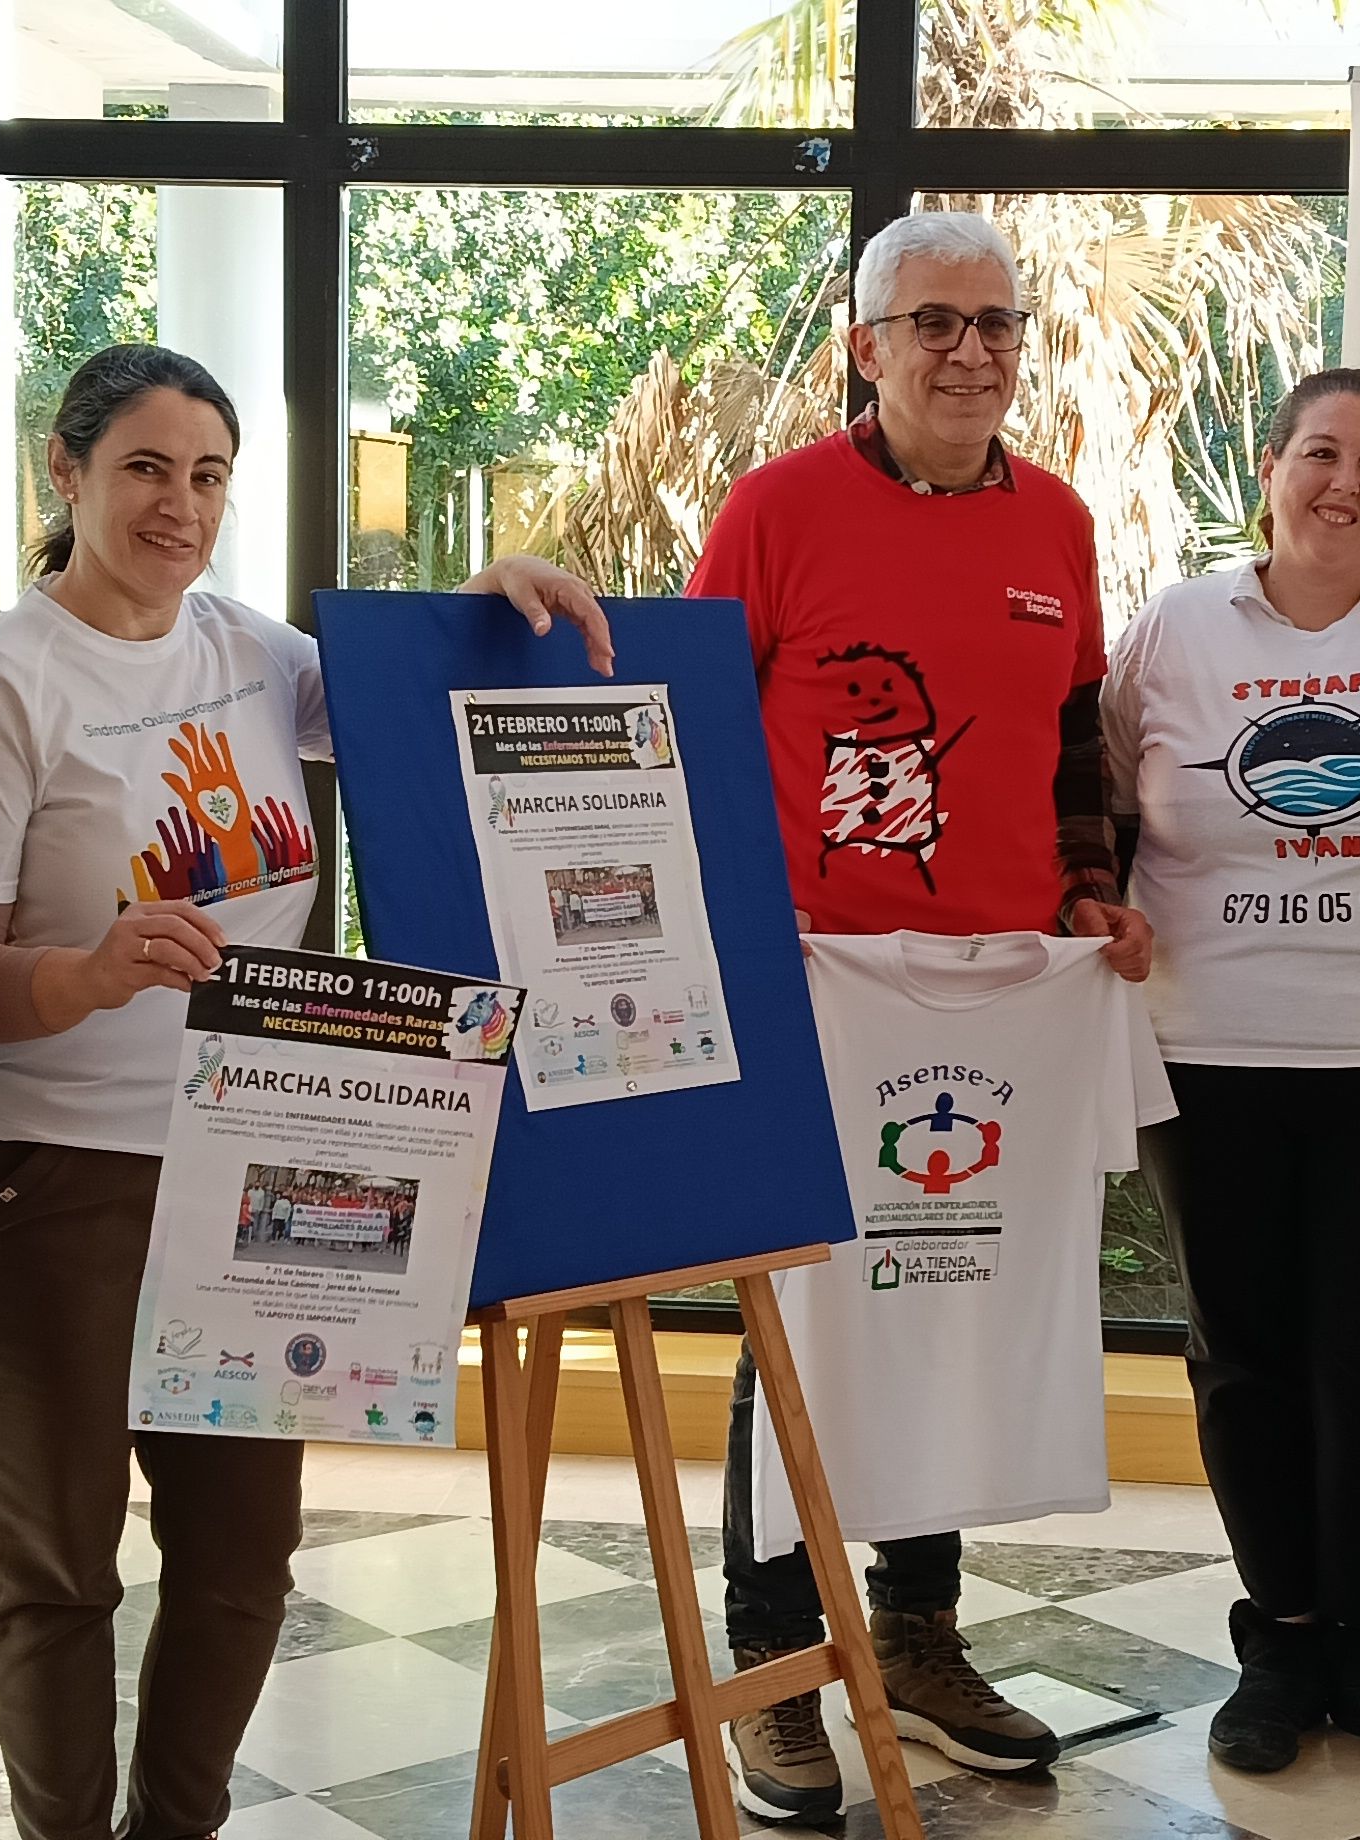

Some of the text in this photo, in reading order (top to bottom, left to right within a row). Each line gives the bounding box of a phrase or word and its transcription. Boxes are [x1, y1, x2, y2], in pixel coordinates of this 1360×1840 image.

[1007, 587, 1061, 607] Duchenne
[1026, 601, 1063, 619] España
[471, 713, 621, 735] 21 FEBRERO 11:00h
[496, 741, 515, 752] Mes
[516, 741, 528, 752] de
[529, 740, 542, 751] las
[544, 740, 604, 751] Enfermedades
[520, 753, 630, 766] NECESITAMOS TU APOYO
[507, 792, 666, 815] MARCHA SOLIDARIA
[1223, 893, 1270, 923] 679
[1279, 893, 1308, 923] 16
[1318, 892, 1352, 922] 05
[244, 963, 354, 996] FEBRERO
[363, 979, 442, 1008] 11:00h
[232, 994, 445, 1031] Mes de las Enfermedades Raras
[263, 1016, 438, 1049] NECESITAMOS TU APOYO
[220, 1065, 472, 1113] MARCHA SOLIDARIA
[875, 1064, 1014, 1107] Asense-A
[921, 1201, 932, 1209] DE
[946, 1212, 958, 1221] DE
[895, 1239, 969, 1251] Colaborador
[906, 1256, 976, 1269] LA TIENDA
[905, 1269, 991, 1283] INTELIGENTE
[214, 1370, 258, 1381] AESCOV
